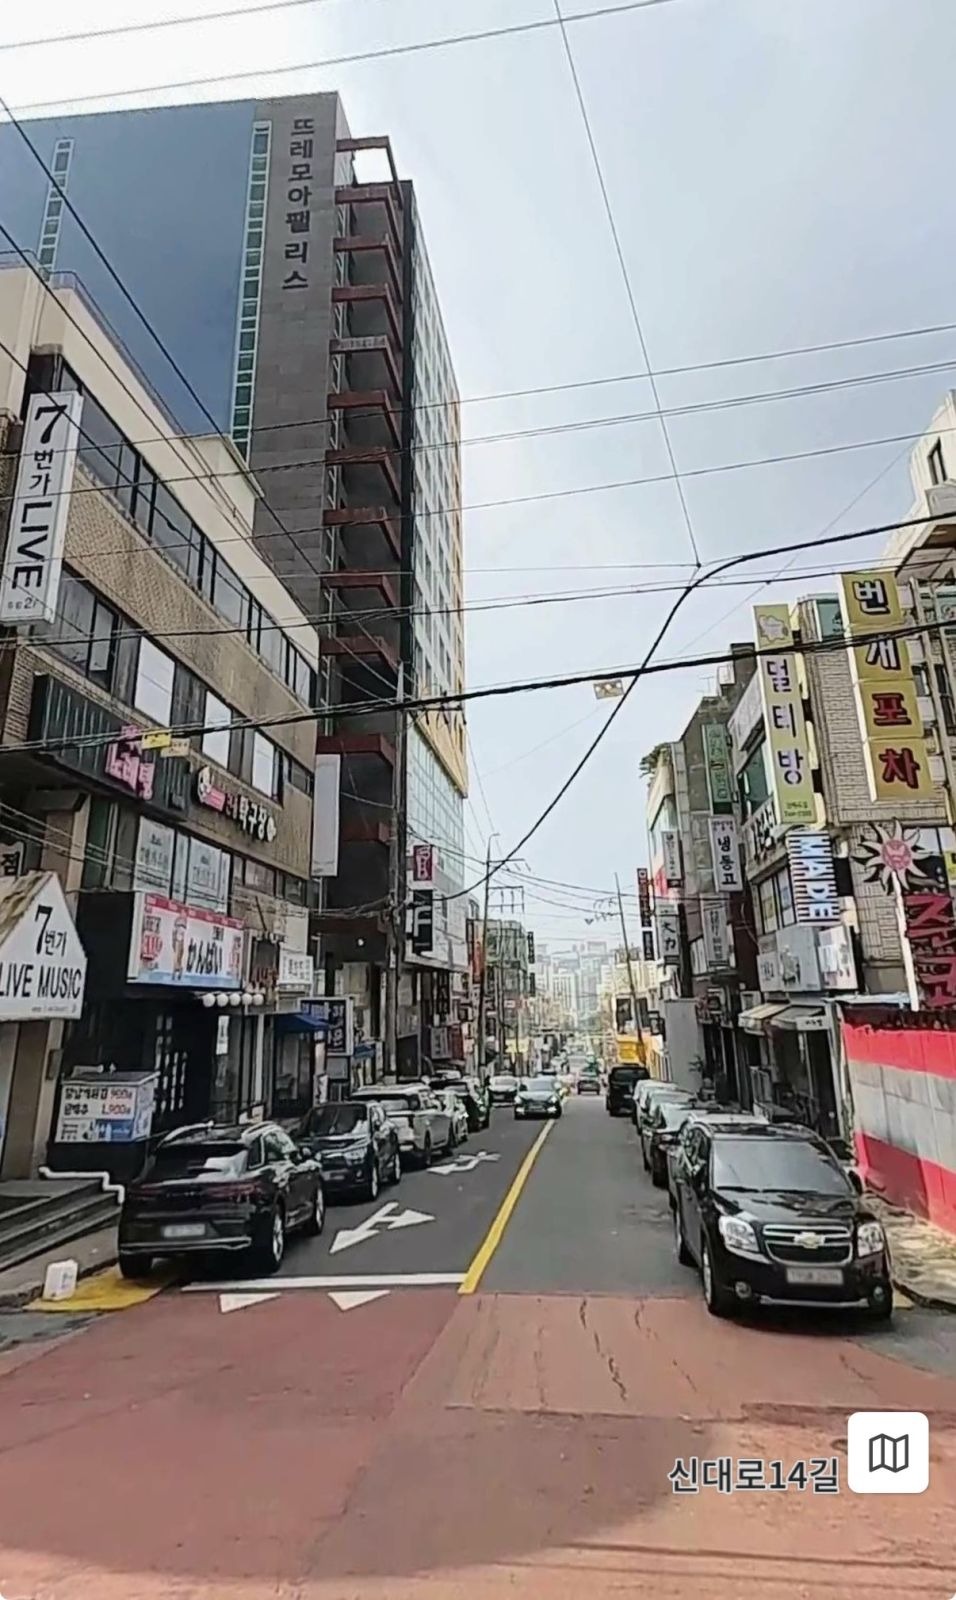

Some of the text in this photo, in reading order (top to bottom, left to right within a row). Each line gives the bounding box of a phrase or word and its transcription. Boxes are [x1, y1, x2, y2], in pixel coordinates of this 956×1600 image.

[11, 501, 53, 590] LIVE
[851, 578, 921, 790] 번개포차
[0, 961, 82, 999] LIVE MUSIC
